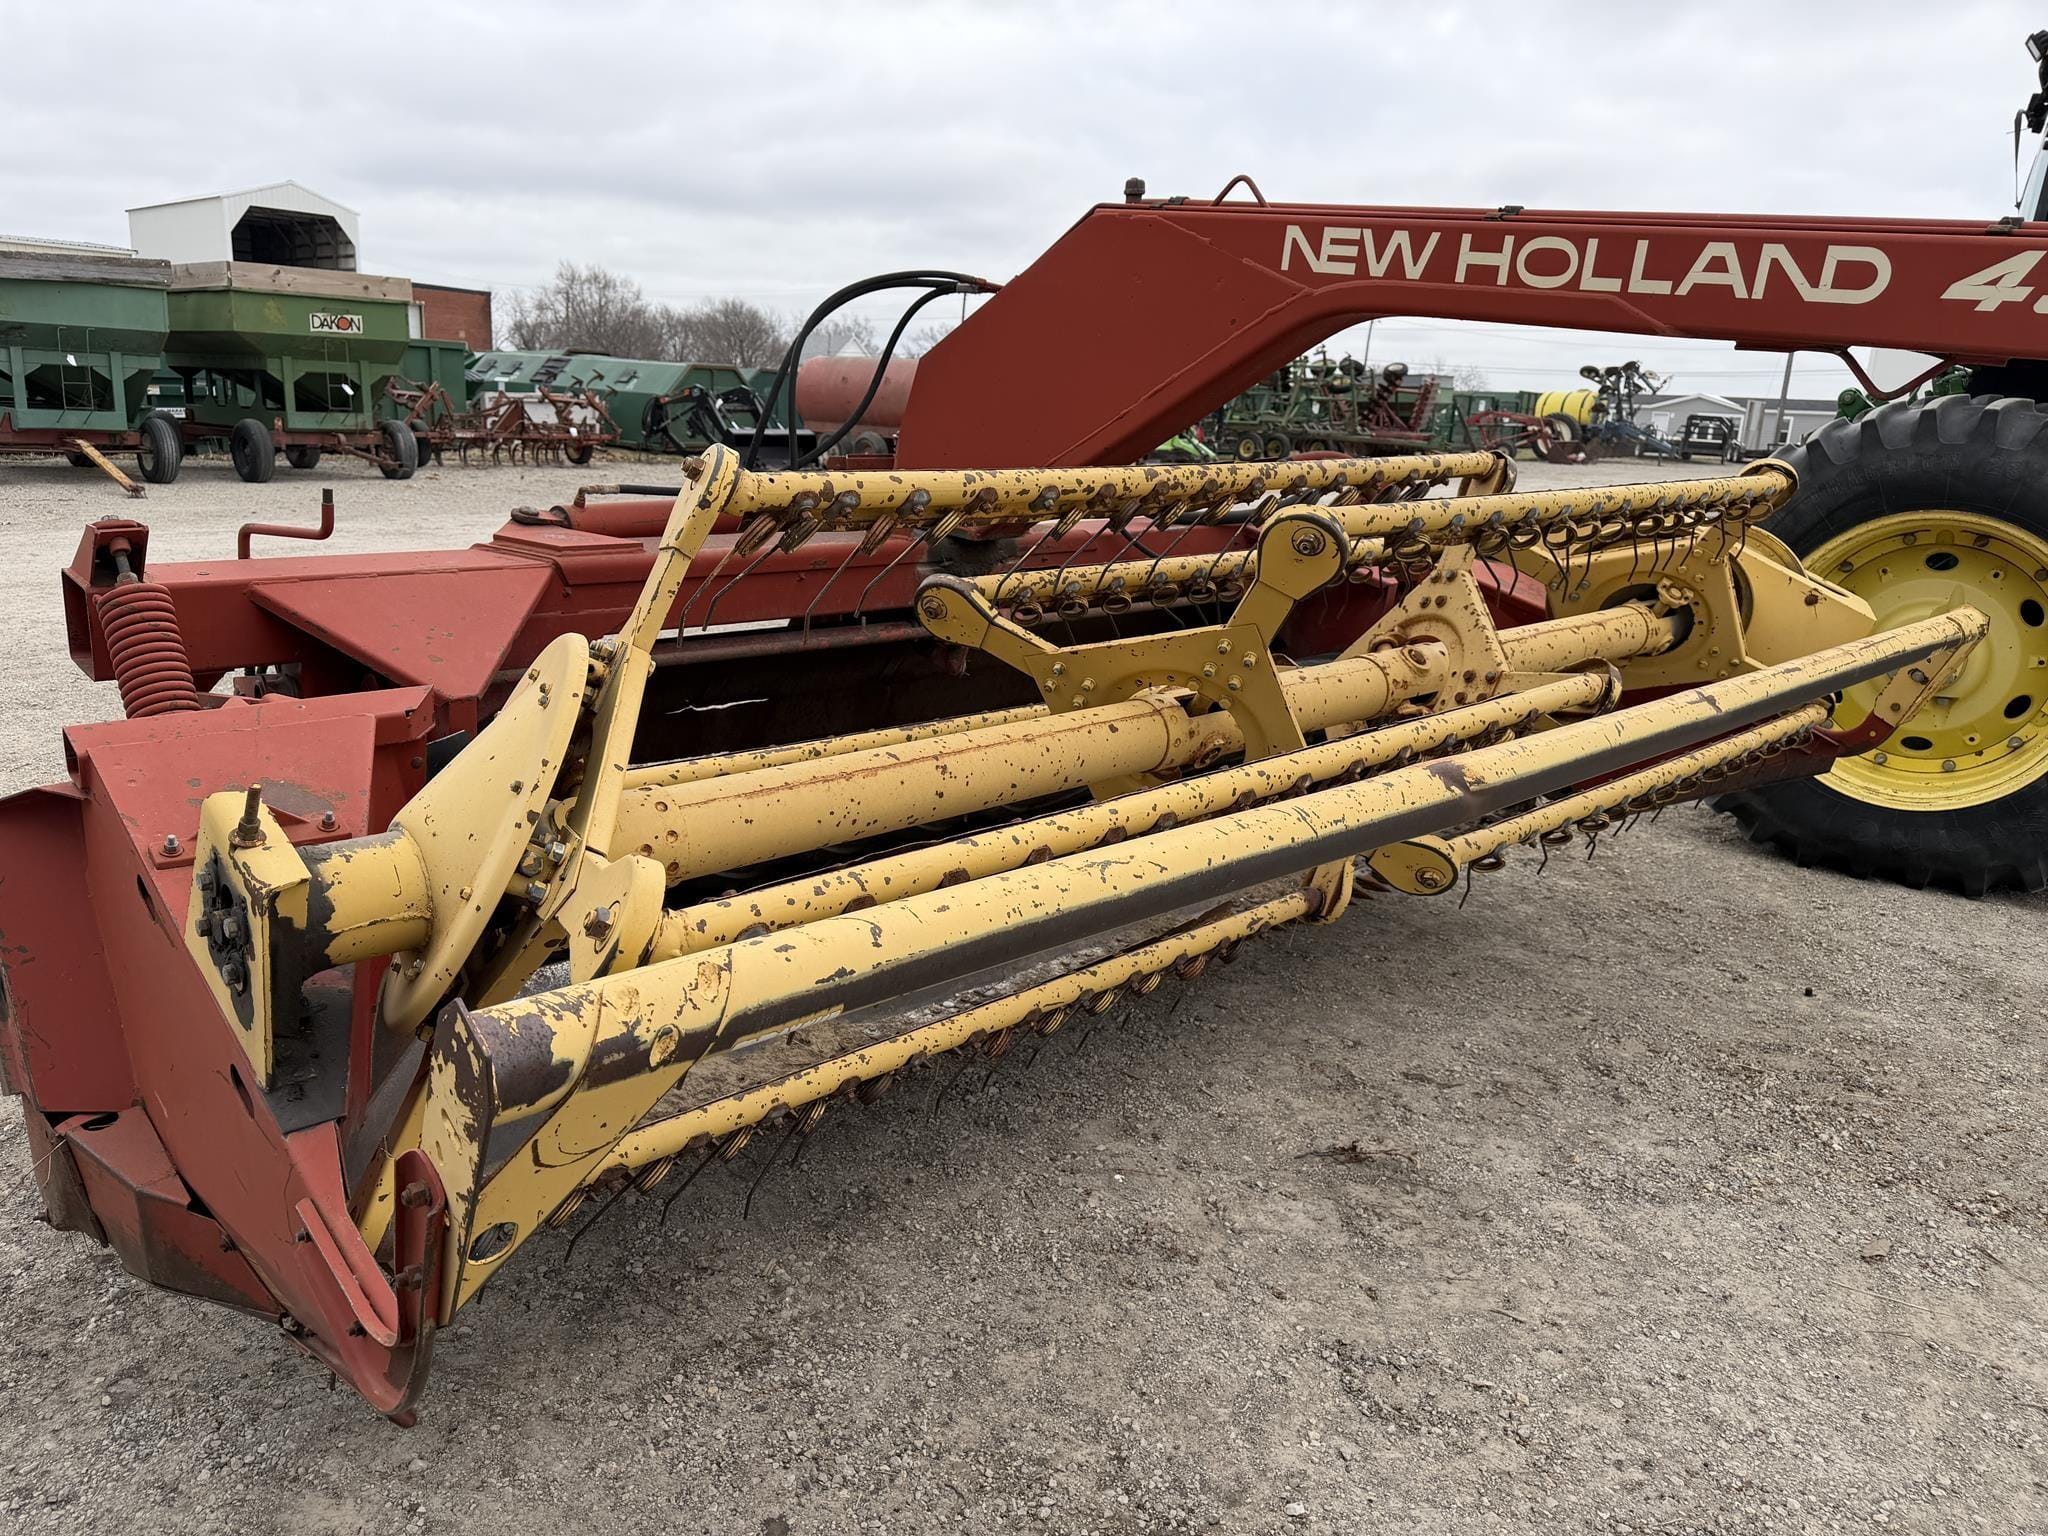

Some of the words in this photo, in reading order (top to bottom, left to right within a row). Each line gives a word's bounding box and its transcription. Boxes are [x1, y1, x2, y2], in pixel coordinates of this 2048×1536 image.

[1280, 224, 1442, 280] NEW
[1454, 232, 1892, 305] HOLLAND
[1940, 249, 2048, 314] 4
[311, 314, 361, 332] DAKON
